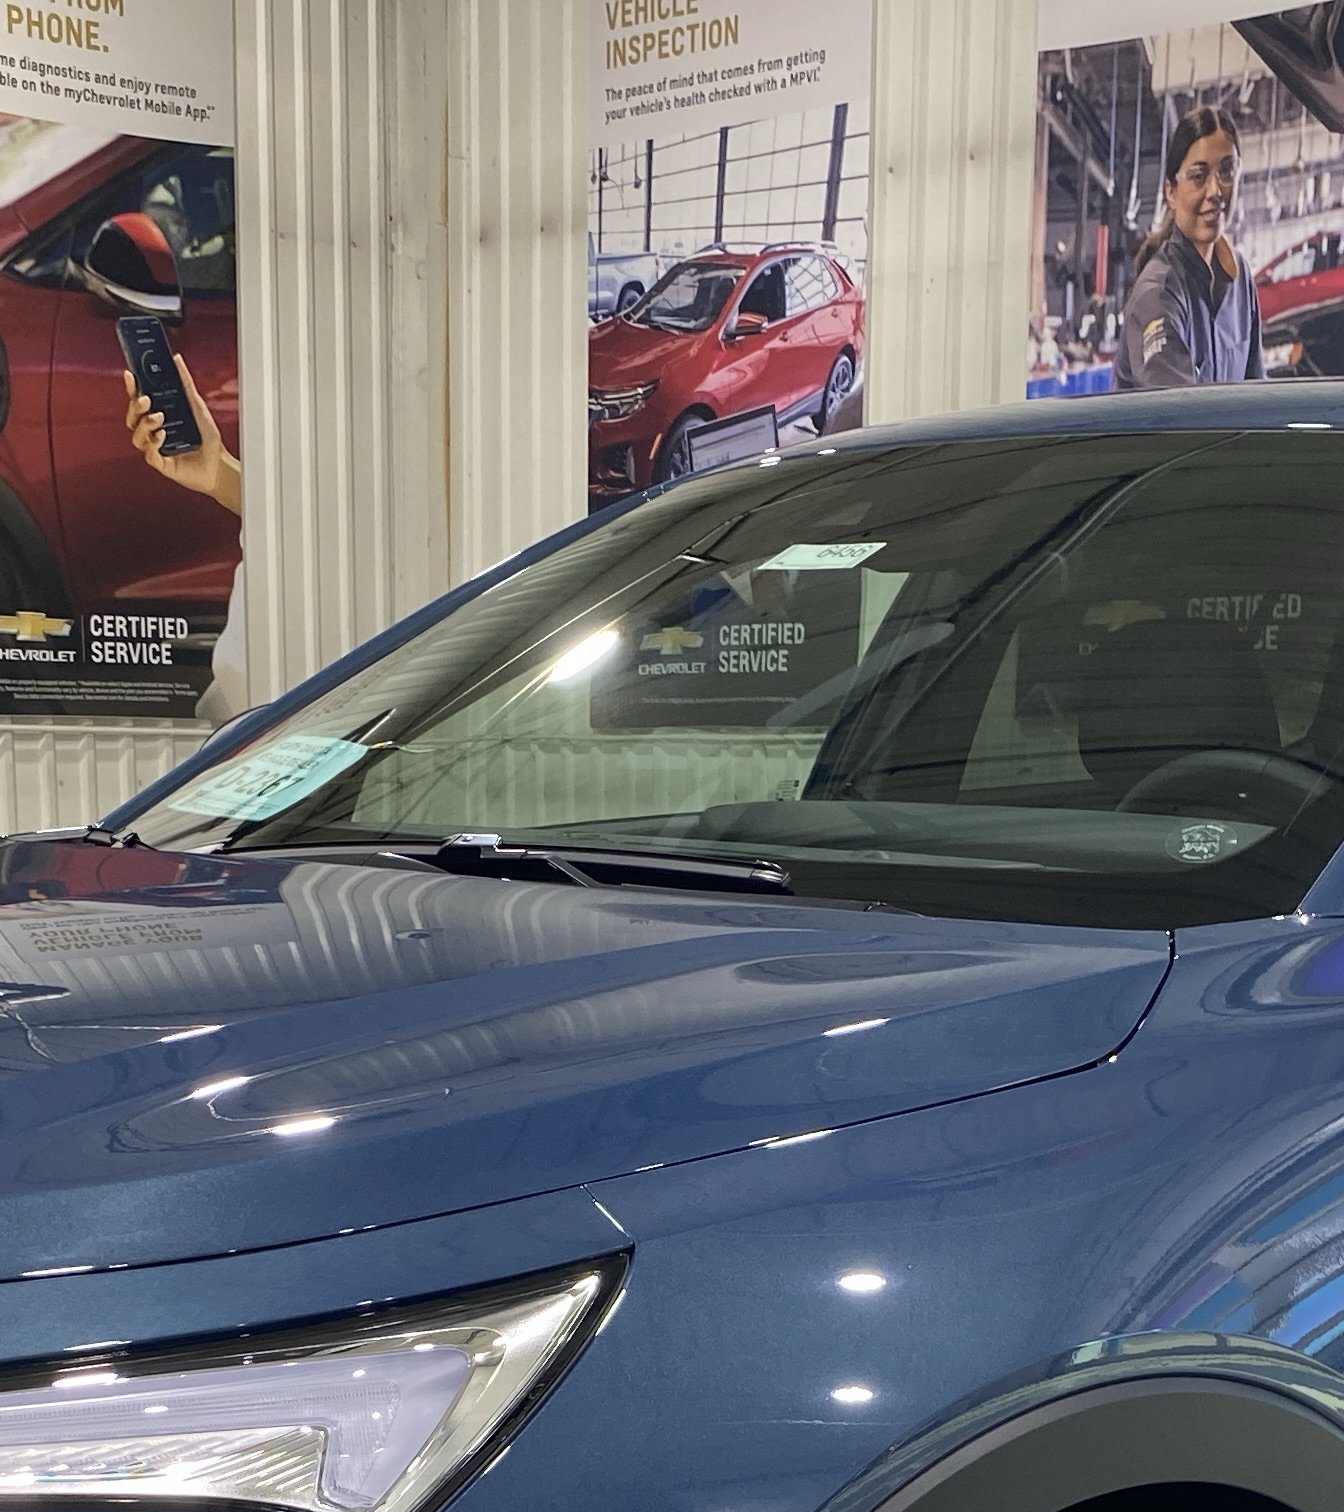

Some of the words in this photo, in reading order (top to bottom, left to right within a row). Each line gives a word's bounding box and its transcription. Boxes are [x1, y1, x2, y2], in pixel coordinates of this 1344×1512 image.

[7, 4, 110, 53] PHONE.
[606, 0, 699, 31] VEHICLE
[606, 14, 739, 70] INSPECTION
[19, 55, 91, 82] diagnostics
[94, 71, 116, 87] and
[120, 76, 152, 96] enjoy
[154, 82, 197, 99] remote
[605, 87, 623, 102] The
[625, 81, 654, 105] peace
[656, 77, 668, 93] of
[669, 72, 694, 90] mind
[697, 69, 719, 85] that
[720, 64, 755, 81] comes
[757, 57, 783, 74] from
[786, 48, 826, 71] getting
[21, 80, 37, 93] on
[40, 80, 61, 96] the
[64, 86, 142, 112] myChevrolet
[144, 99, 182, 117] Mobile
[605, 105, 627, 125] your
[673, 90, 706, 109] health
[708, 81, 751, 104] checked
[754, 76, 778, 95] with
[89, 614, 188, 640] CERTIFIED
[718, 622, 806, 646] CERTIFIED
[90, 641, 174, 666] SERVICE
[638, 661, 707, 676] CHEVROLET
[718, 649, 790, 674] SERVICE
